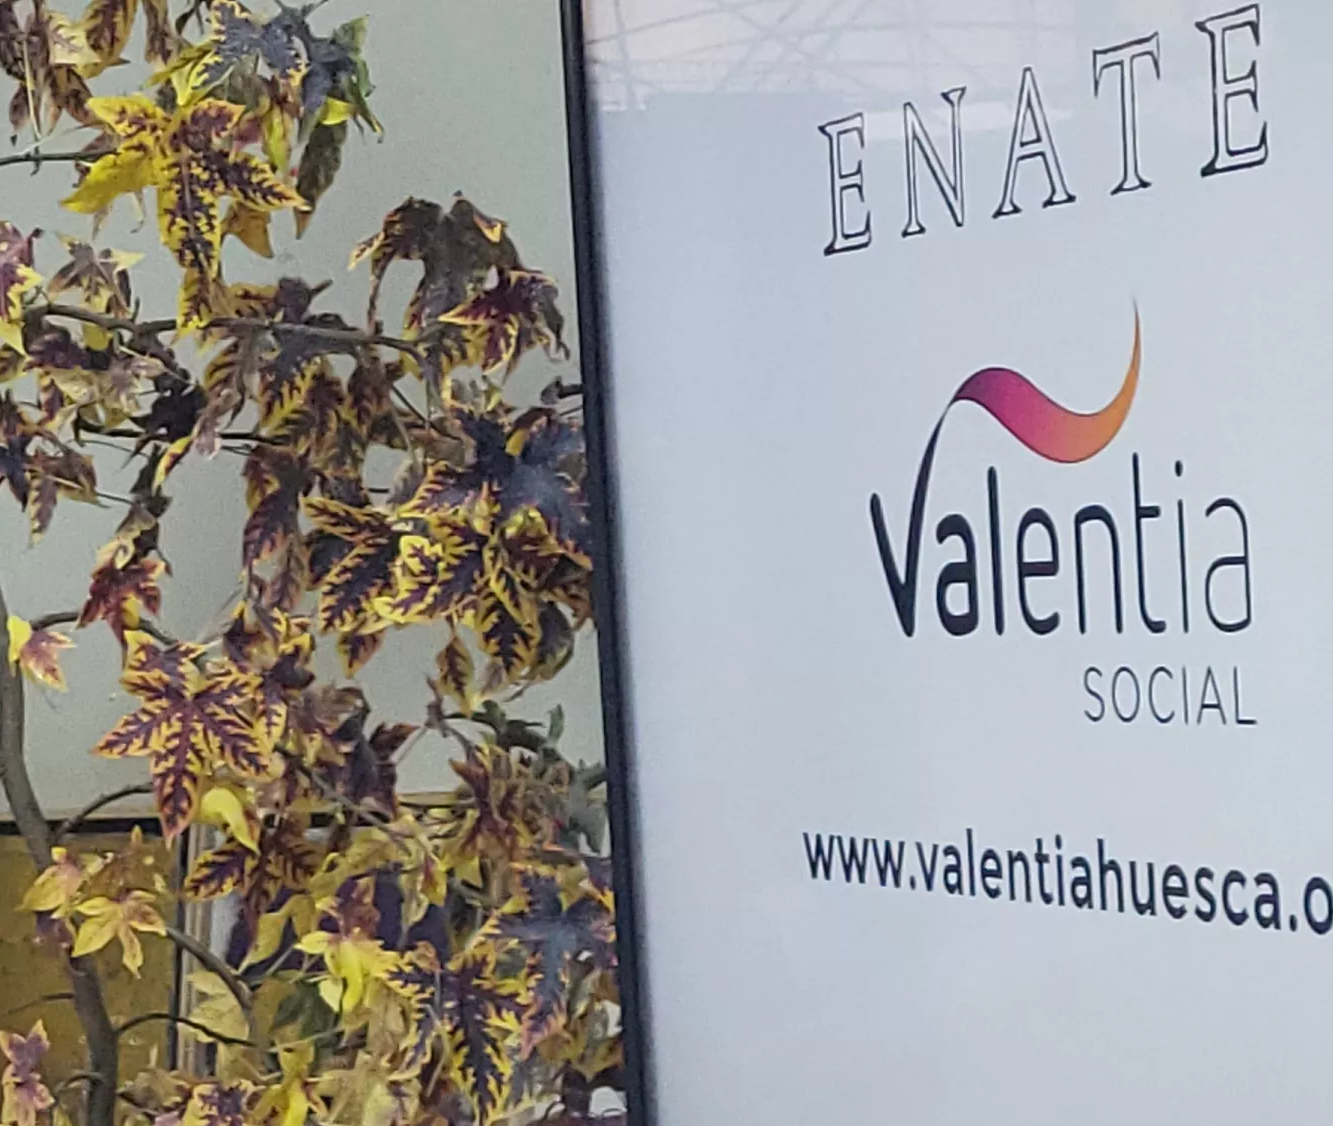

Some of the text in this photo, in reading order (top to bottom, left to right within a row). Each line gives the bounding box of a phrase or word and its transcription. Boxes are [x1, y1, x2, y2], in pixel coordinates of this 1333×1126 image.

[817, 3, 1269, 256] ENATE
[869, 430, 1252, 638] Valentia
[1083, 665, 1258, 726] SOCIAL
[802, 827, 1333, 936] www.valentiahuesca.o
